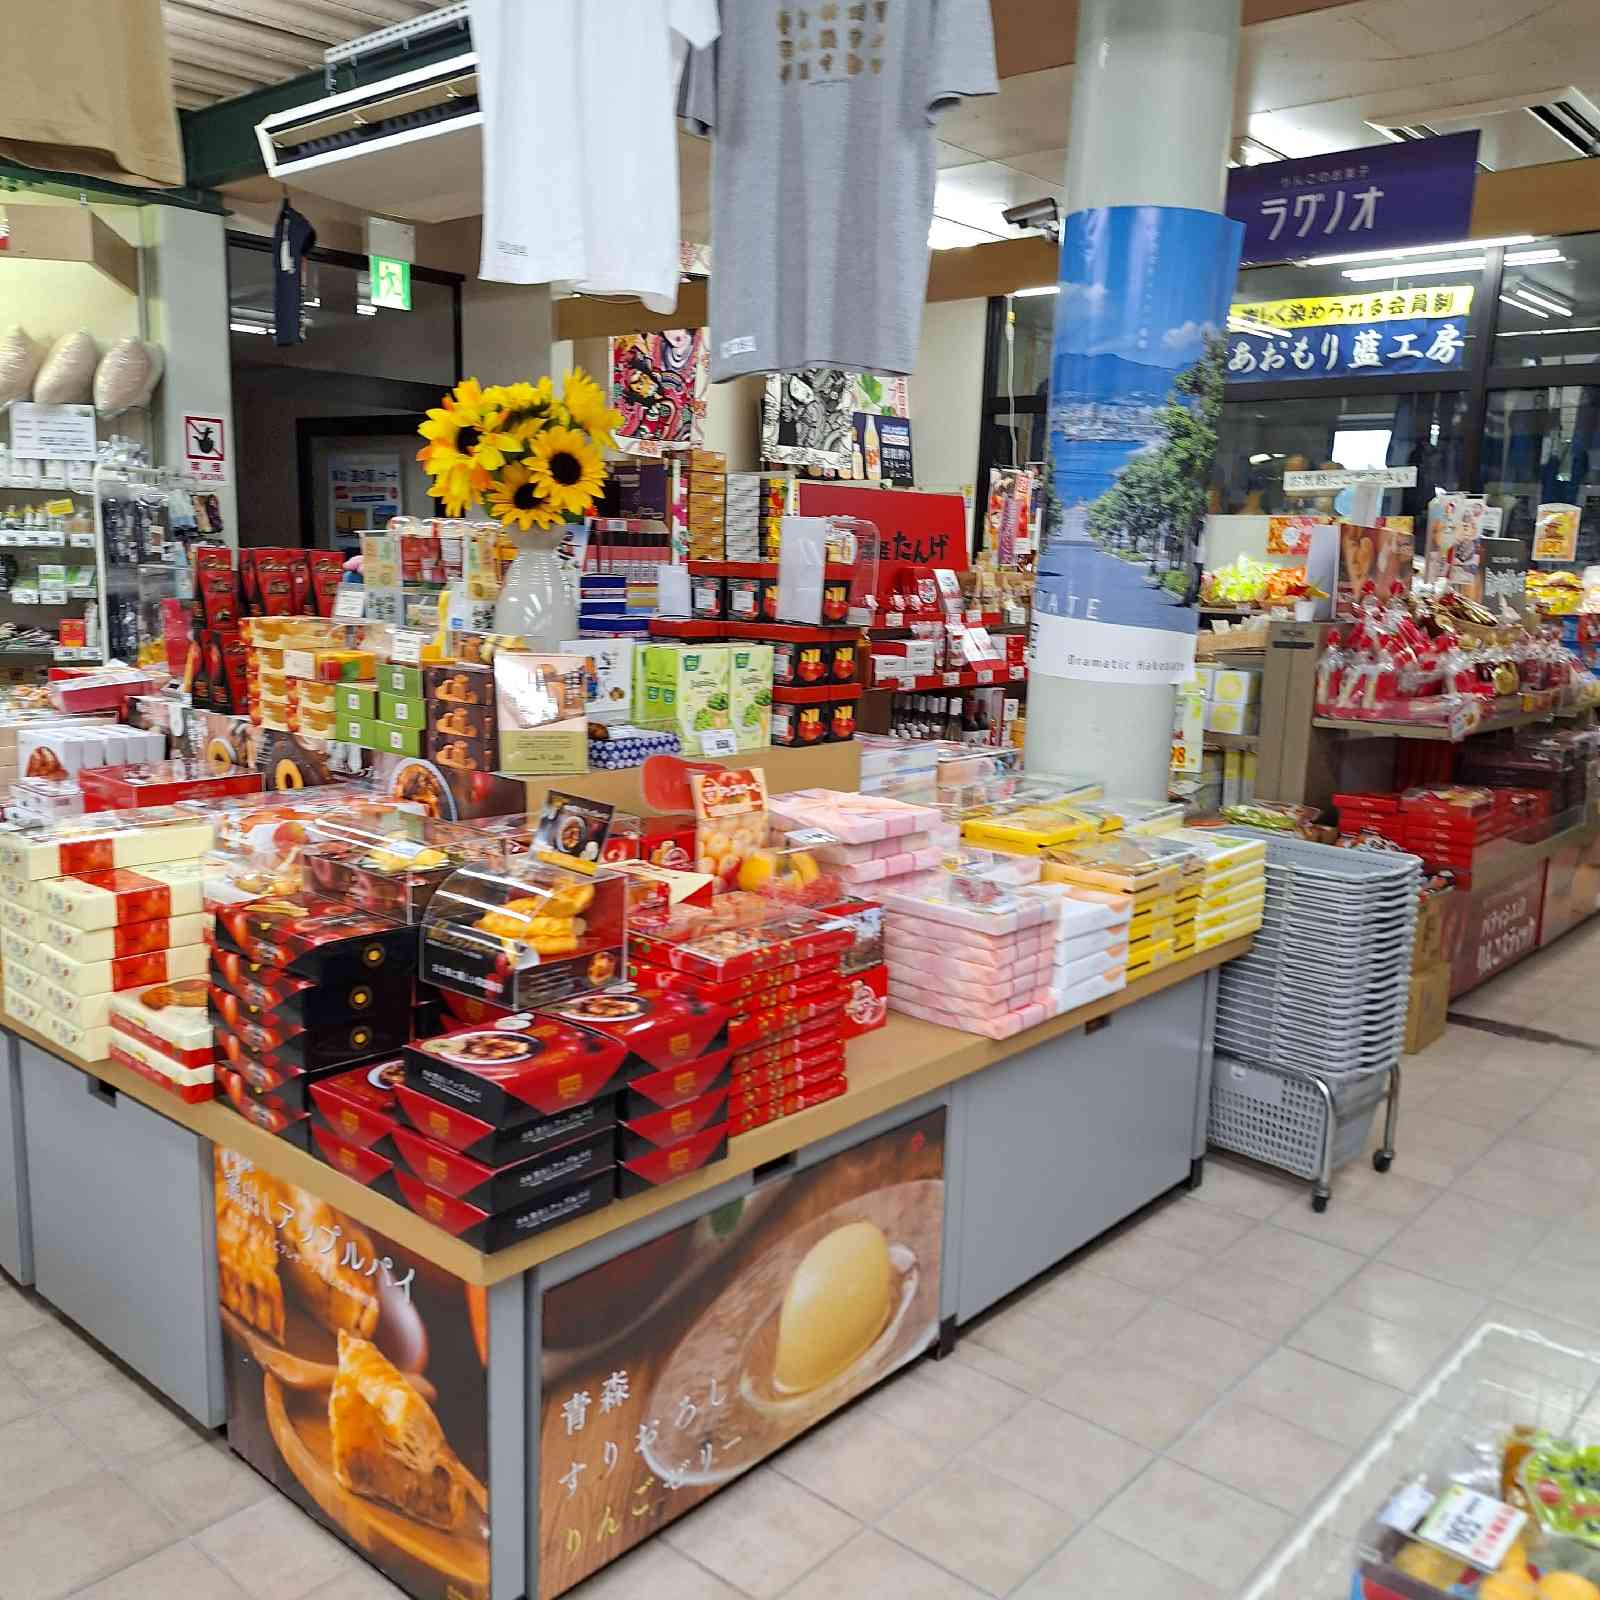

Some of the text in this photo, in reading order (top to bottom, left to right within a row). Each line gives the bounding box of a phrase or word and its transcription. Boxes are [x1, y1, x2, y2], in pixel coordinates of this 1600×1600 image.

[1261, 186, 1385, 241] ラグノオ
[1227, 322, 1466, 374] あおもり藍工房
[1066, 653, 1130, 671] Dramatic
[561, 1370, 631, 1436] 青森
